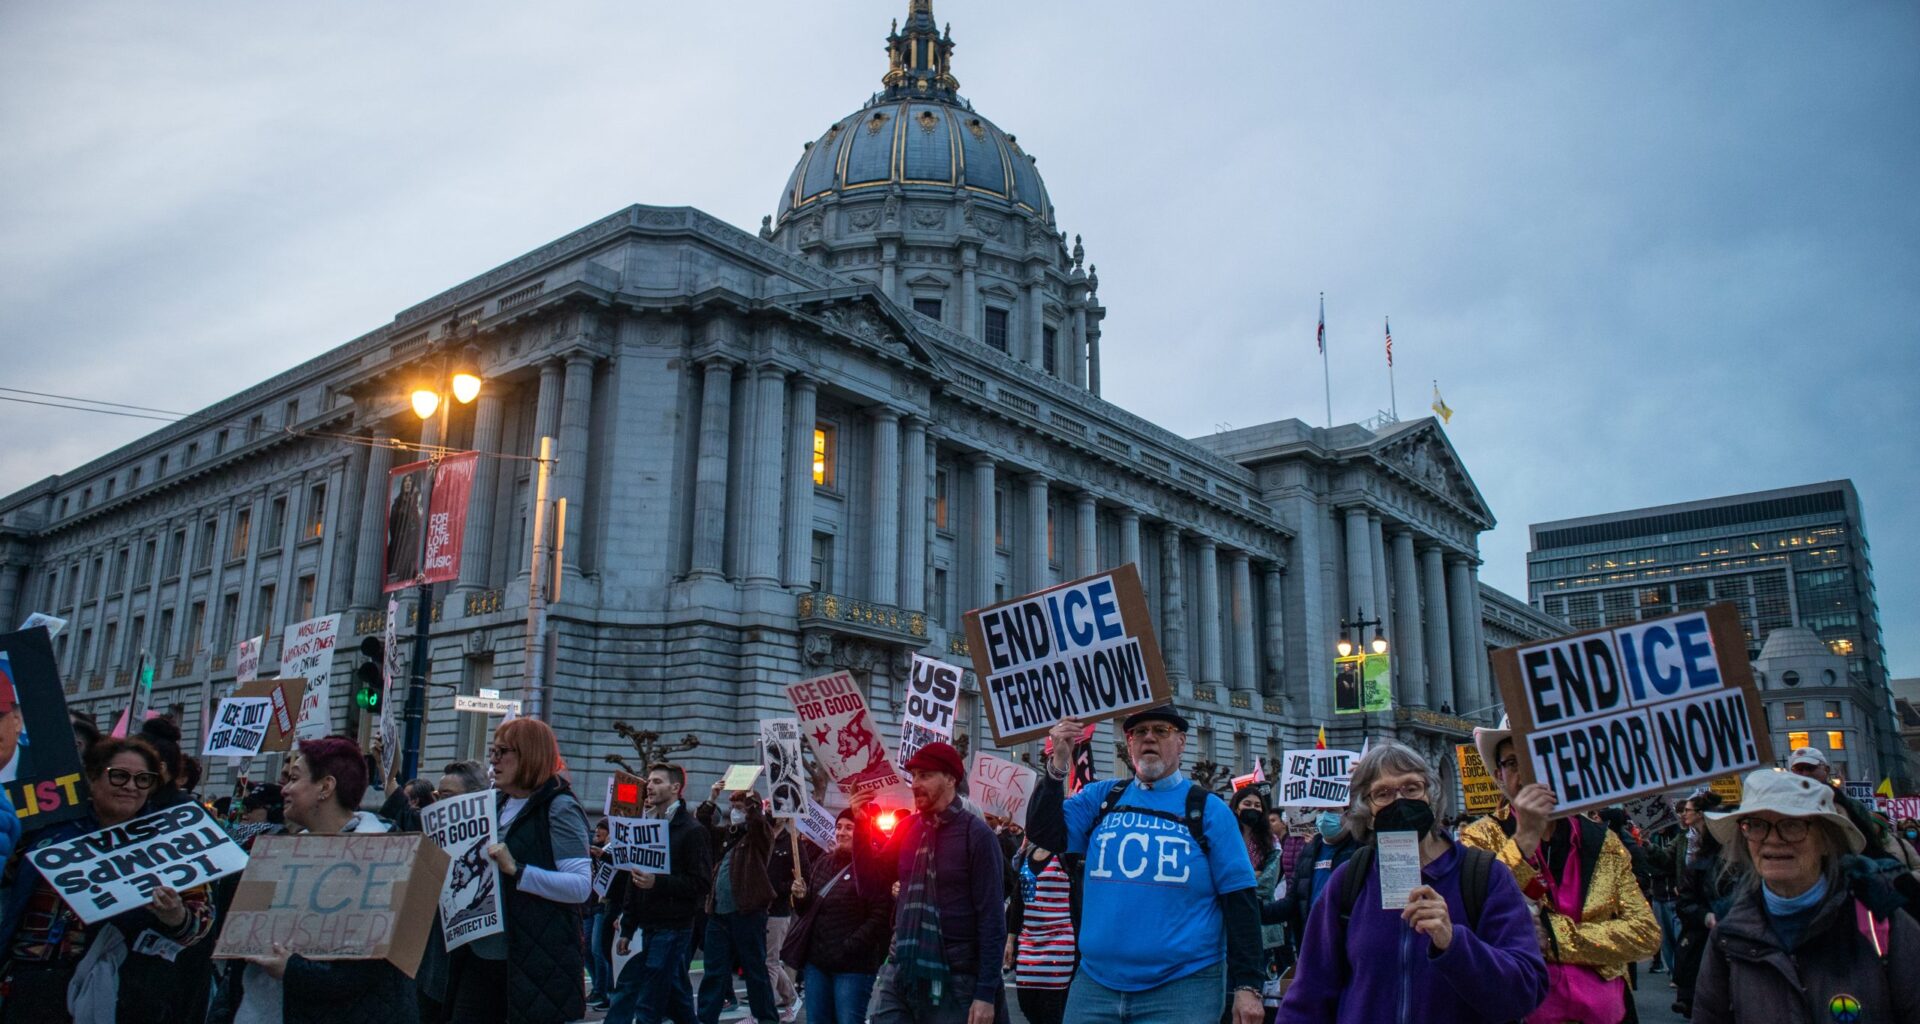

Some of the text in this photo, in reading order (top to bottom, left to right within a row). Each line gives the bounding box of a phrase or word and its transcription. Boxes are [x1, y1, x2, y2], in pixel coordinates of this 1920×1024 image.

[430, 512, 448, 524] FOR
[430, 525, 446, 534] THE
[426, 546, 439, 558] OF
[428, 534, 450, 546] LOVE
[426, 556, 452, 569] MUSIC
[983, 580, 1123, 669] END ICE
[312, 636, 336, 653] POWER
[300, 654, 321, 675] DRIVE
[1524, 618, 1720, 724] END ICE
[788, 675, 853, 704] ICE OUT
[912, 660, 956, 702] US
[991, 642, 1150, 731] TERROR NOW!
[222, 703, 242, 726] ICE
[242, 702, 268, 726] OUT
[796, 693, 863, 722] FOR GOOD
[908, 695, 953, 727] OUT
[209, 728, 262, 751] FOR GOOD!
[903, 720, 913, 742] OF
[1465, 755, 1482, 766] JOBS
[1534, 694, 1756, 805] TERROR NOW!
[979, 758, 1028, 794] FUCK
[1290, 756, 1349, 778] ICE OUT
[884, 774, 900, 786] US
[1284, 780, 1306, 802] FOR
[1309, 778, 1350, 802] GOOD!
[1464, 782, 1500, 794] NOT FOR WA
[976, 780, 1028, 813] TRUMP
[1470, 794, 1500, 805] OCCUPATI
[1846, 788, 1856, 798] NO
[424, 795, 487, 834] ICE OUT
[34, 805, 204, 870] GESTAPO
[428, 817, 490, 848] OR GOOD
[616, 822, 661, 845] ICE OUT
[54, 827, 230, 894] TRUMP'S
[252, 835, 419, 862] I LIKE MY
[614, 846, 629, 865] FOR
[630, 846, 666, 870] GOOD!
[1090, 832, 1190, 883] ICE
[269, 861, 405, 914] ICE
[224, 912, 389, 947] CRUSHED
[453, 918, 482, 938] PROTECT
[484, 914, 498, 927] US
